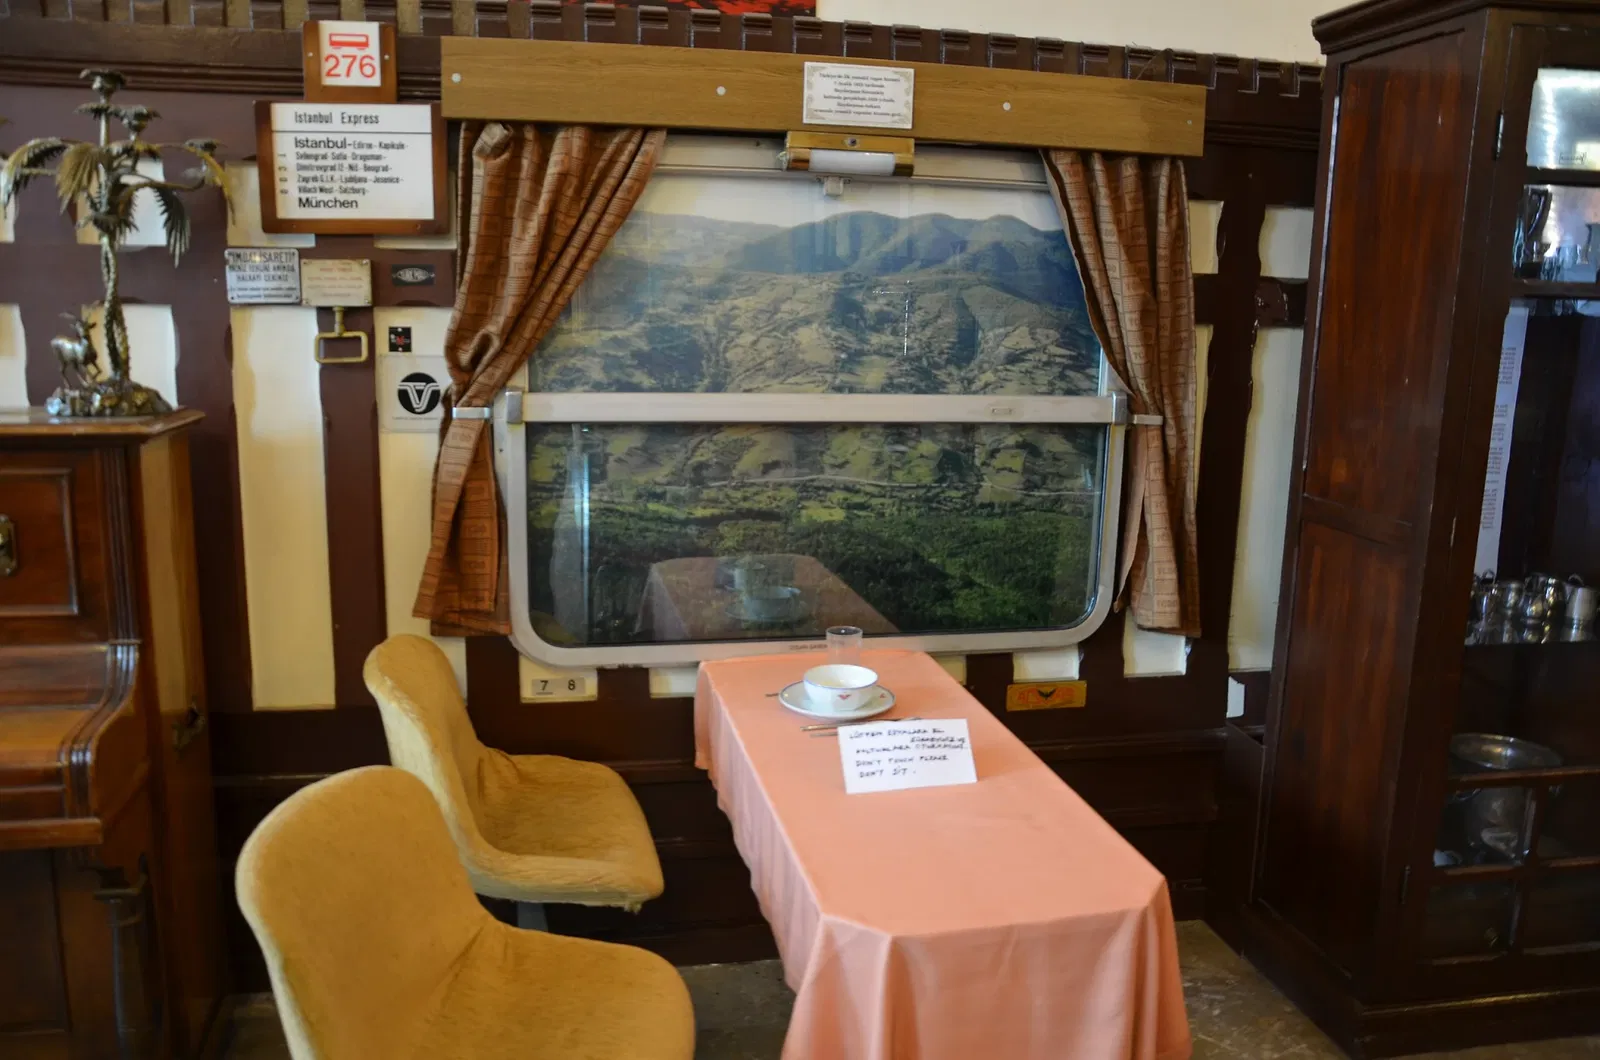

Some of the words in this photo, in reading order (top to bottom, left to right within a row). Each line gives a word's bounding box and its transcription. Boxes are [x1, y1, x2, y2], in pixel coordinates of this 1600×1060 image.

[323, 53, 376, 79] 276
[294, 111, 333, 124] Istanbul
[340, 111, 380, 127] Express
[298, 197, 358, 209] München
[540, 680, 549, 691] 7
[567, 679, 576, 691] 8
